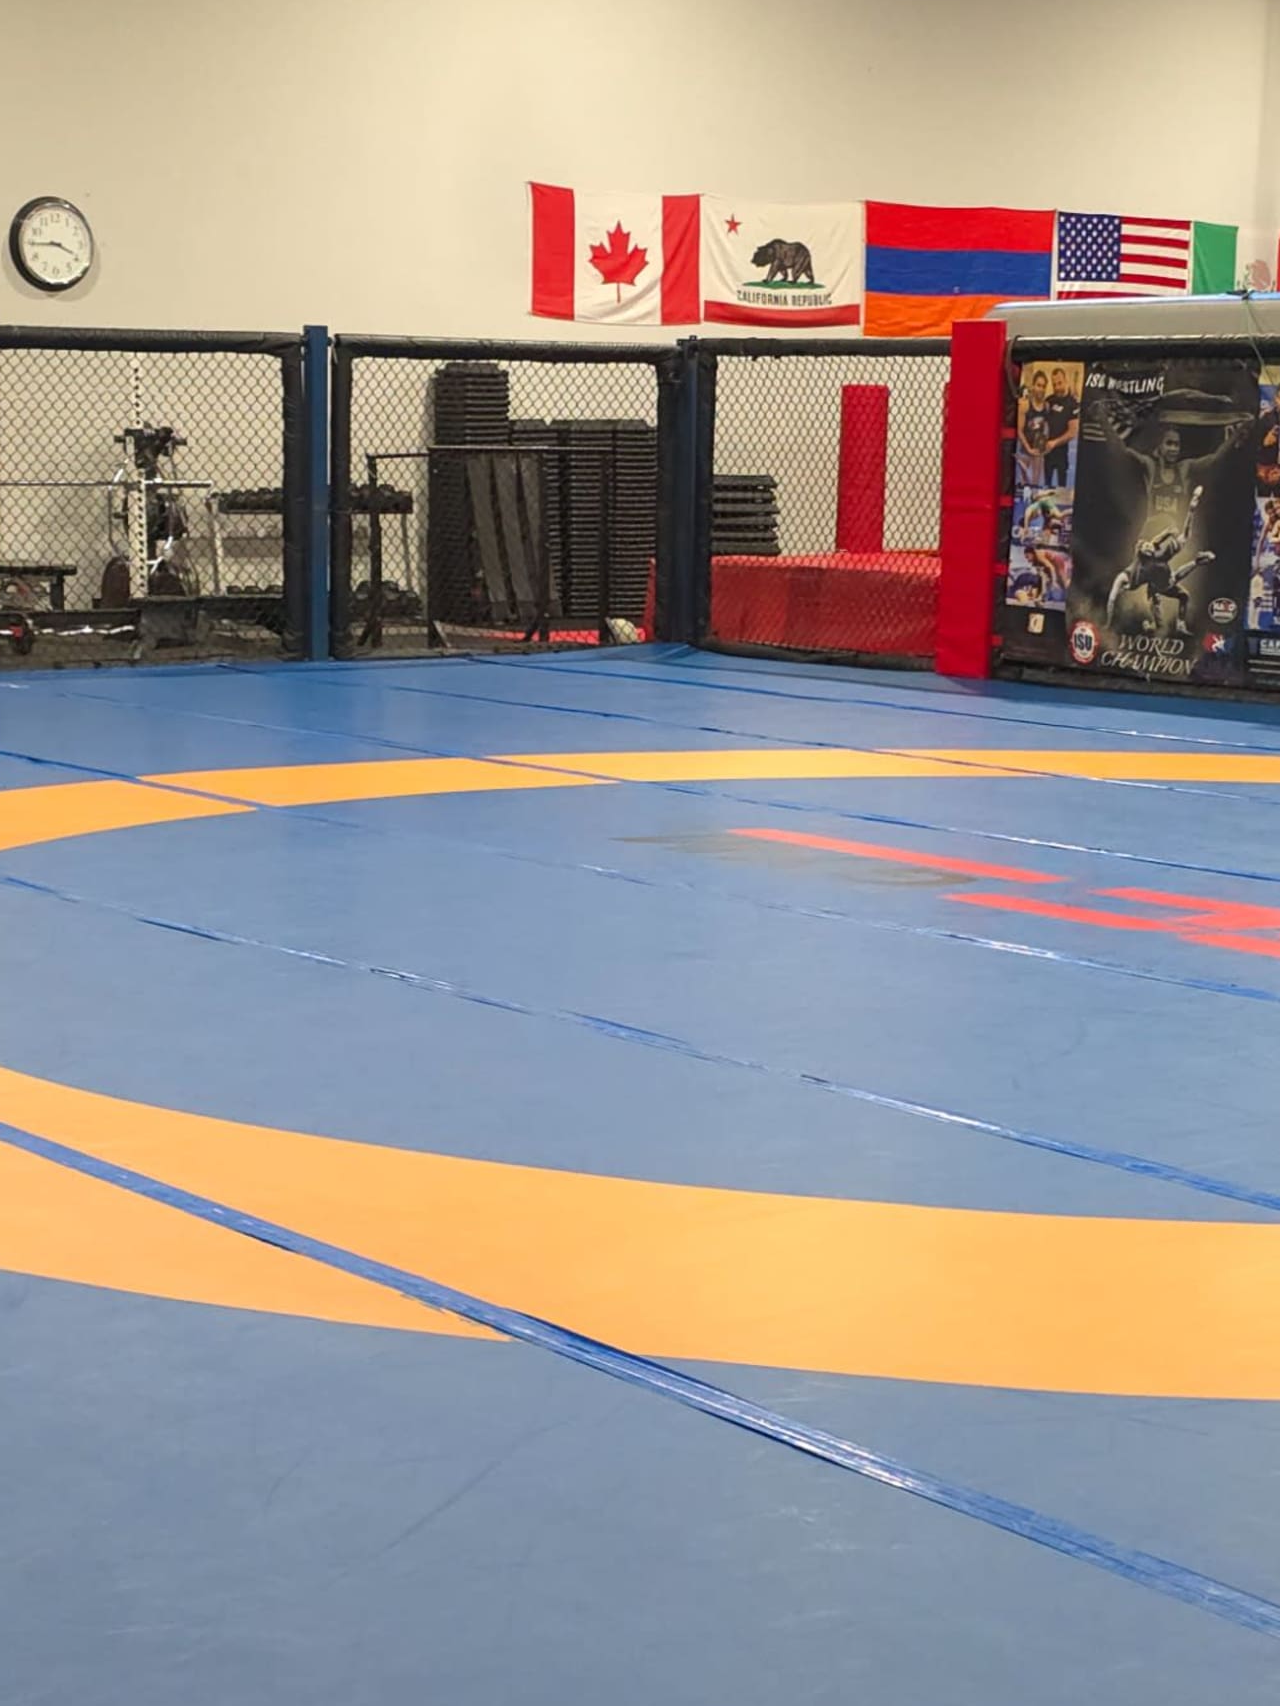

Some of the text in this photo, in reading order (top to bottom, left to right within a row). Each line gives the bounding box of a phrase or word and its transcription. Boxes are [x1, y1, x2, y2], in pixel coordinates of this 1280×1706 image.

[49, 213, 61, 224] 12
[1073, 632, 1094, 652] ISU
[1119, 633, 1185, 656] WORLD
[1100, 649, 1199, 675] CHAMPION
